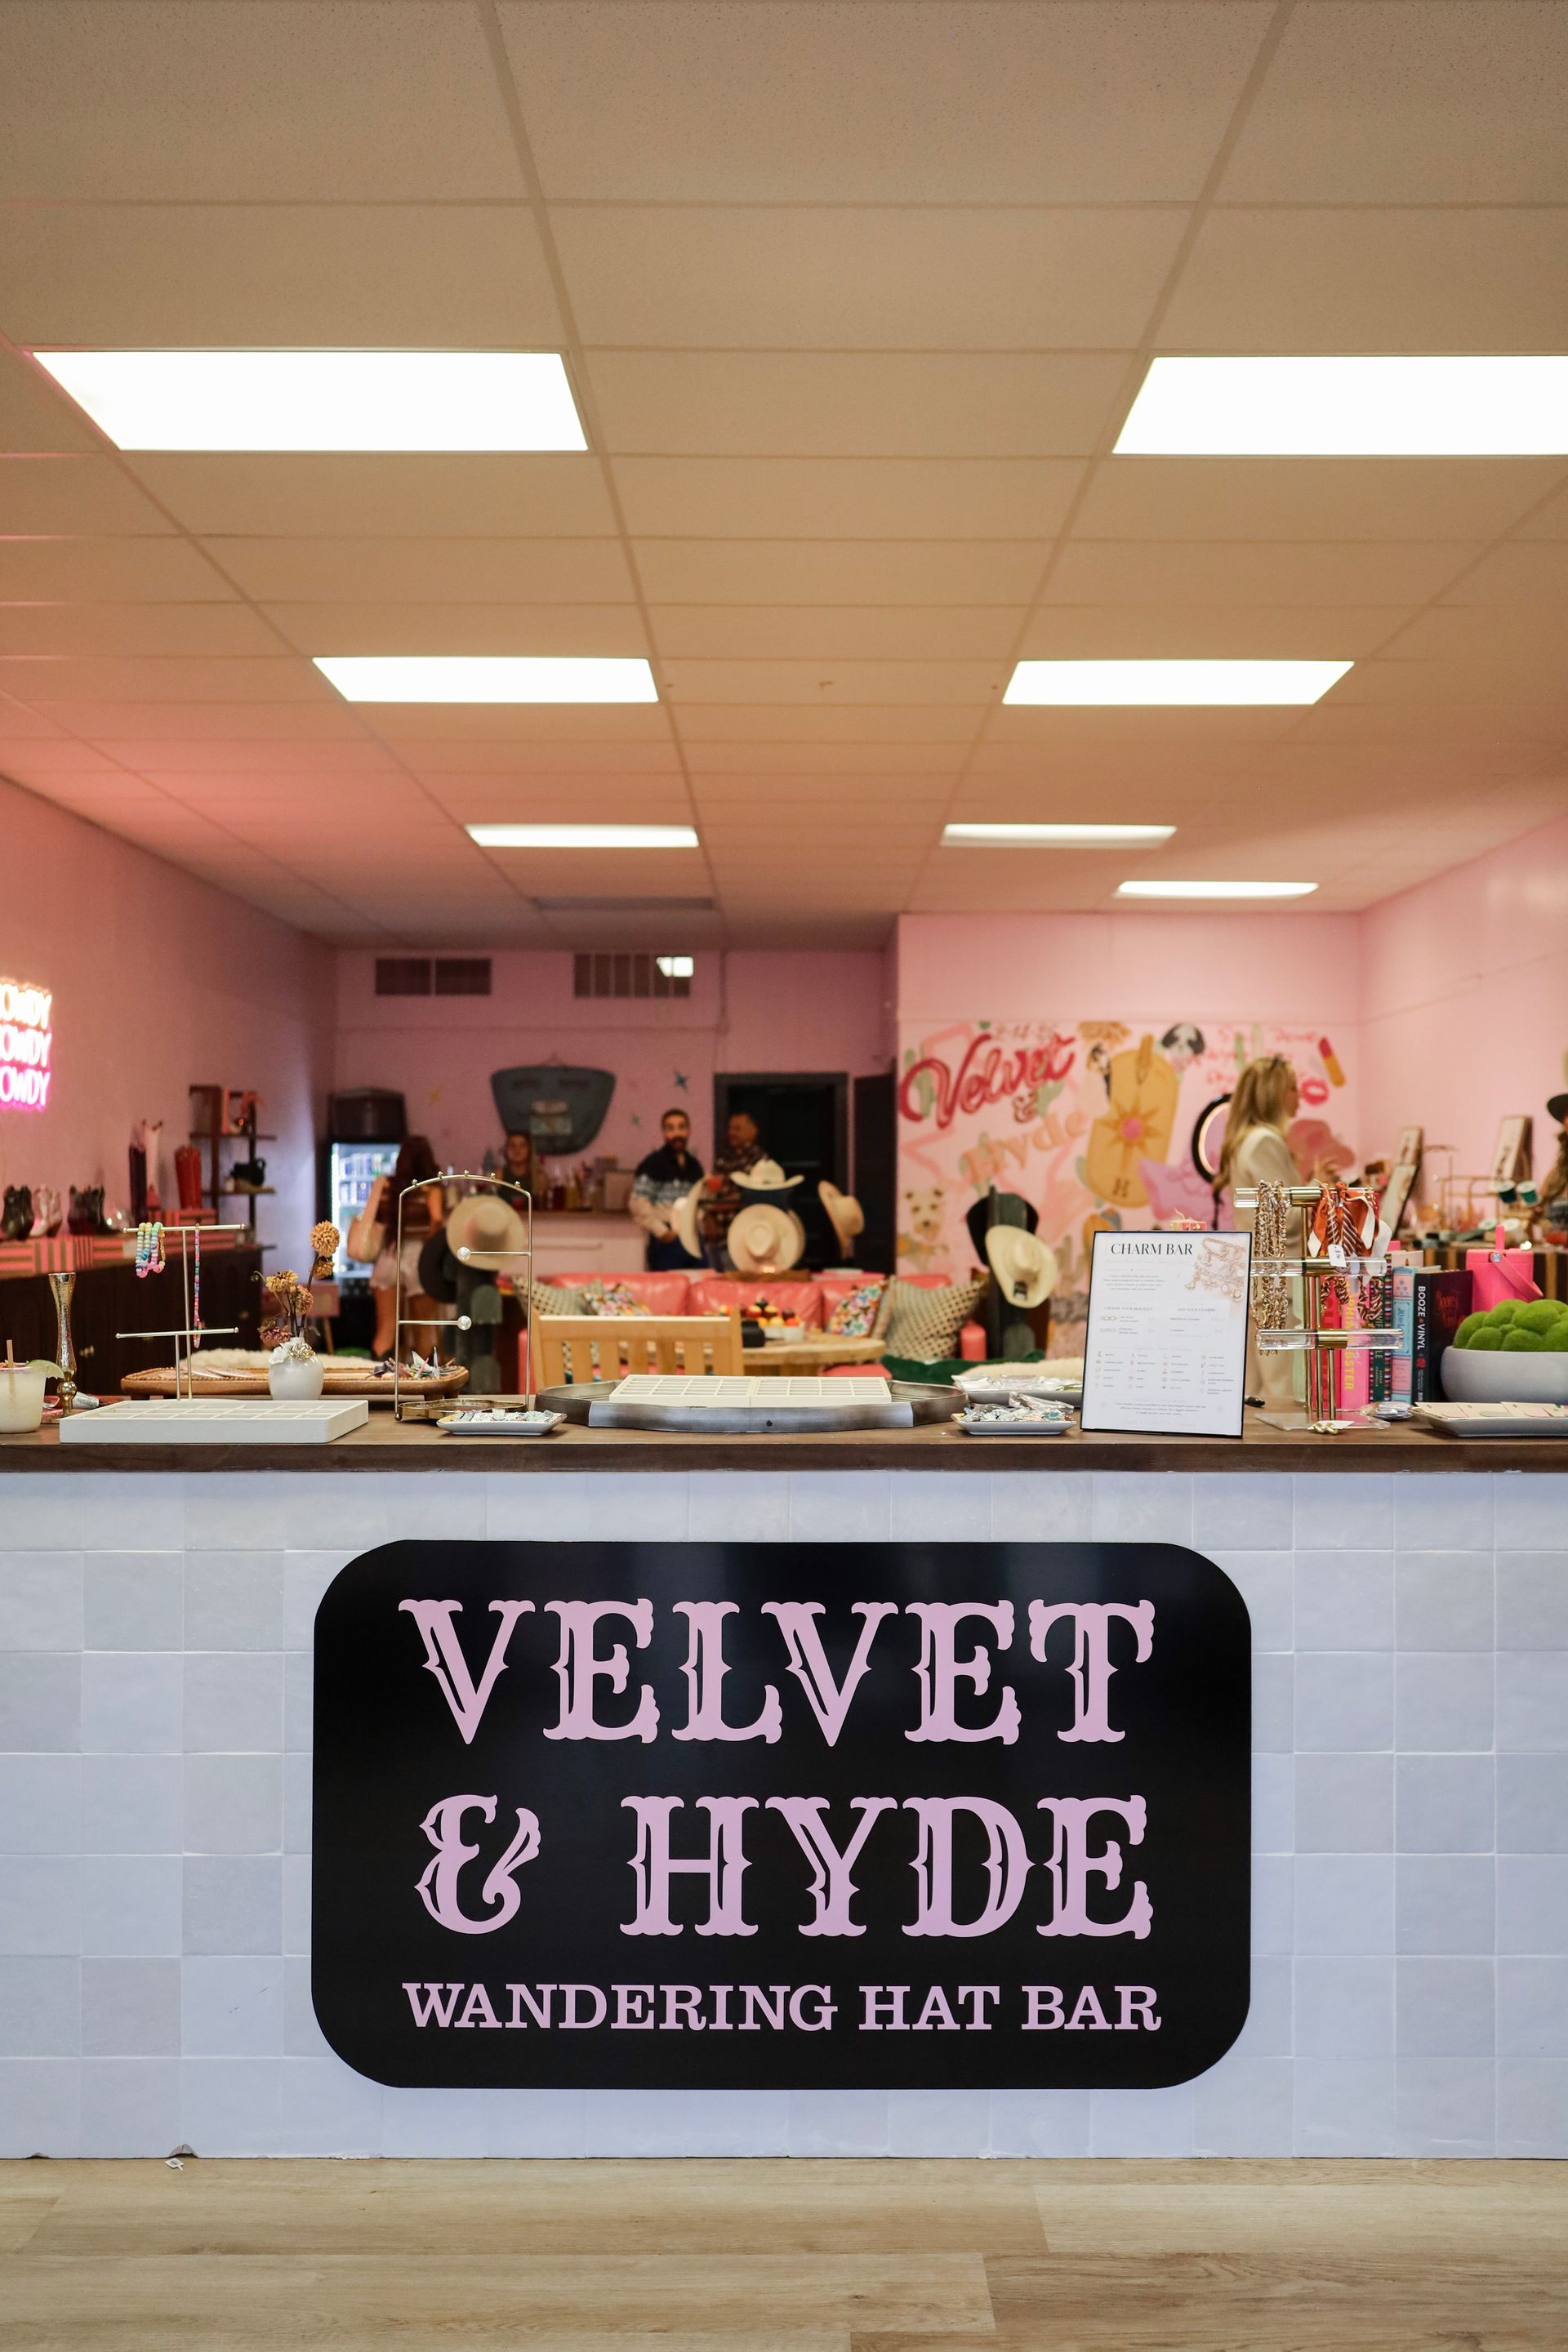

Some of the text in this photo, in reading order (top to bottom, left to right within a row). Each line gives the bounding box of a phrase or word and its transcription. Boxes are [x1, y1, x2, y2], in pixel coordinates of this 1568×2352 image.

[0, 983, 52, 1030] OWDY
[0, 1024, 52, 1067] OWDY
[0, 1066, 51, 1107] OWDY
[899, 1032, 1076, 1129] Velvet
[1111, 1242, 1193, 1255] CHARM BAR
[1417, 1285, 1426, 1317] BOOZE
[1417, 1324, 1426, 1351] VINYL
[399, 1599, 1155, 1746] VELVET
[414, 1795, 1153, 1940] & HYDE
[403, 1983, 1162, 2031] WANDERING HAT BAR
